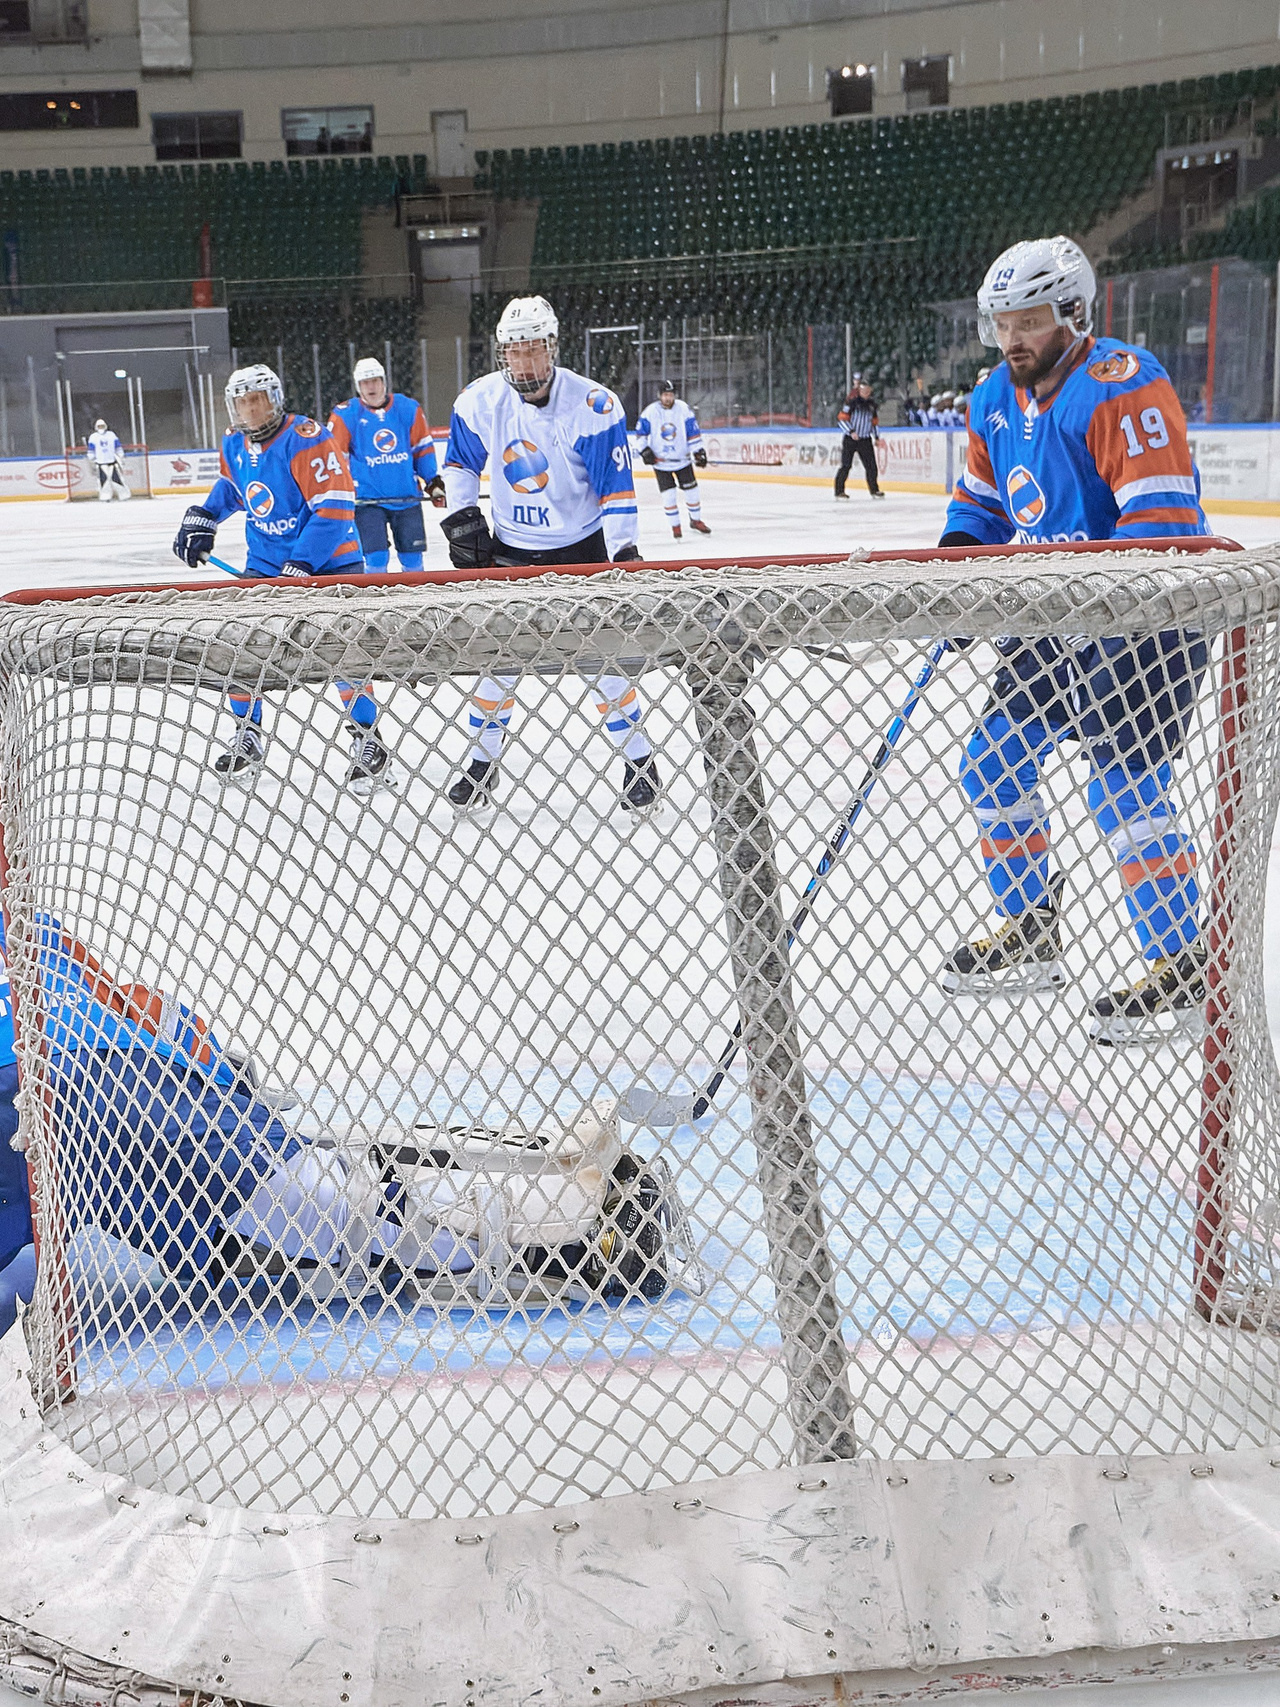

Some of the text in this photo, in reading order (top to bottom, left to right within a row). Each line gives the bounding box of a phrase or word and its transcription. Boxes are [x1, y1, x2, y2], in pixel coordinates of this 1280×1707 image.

[1120, 406, 1170, 459] 19
[310, 451, 344, 484] 24
[612, 446, 632, 472] 91
[37, 470, 81, 481] SINTEC
